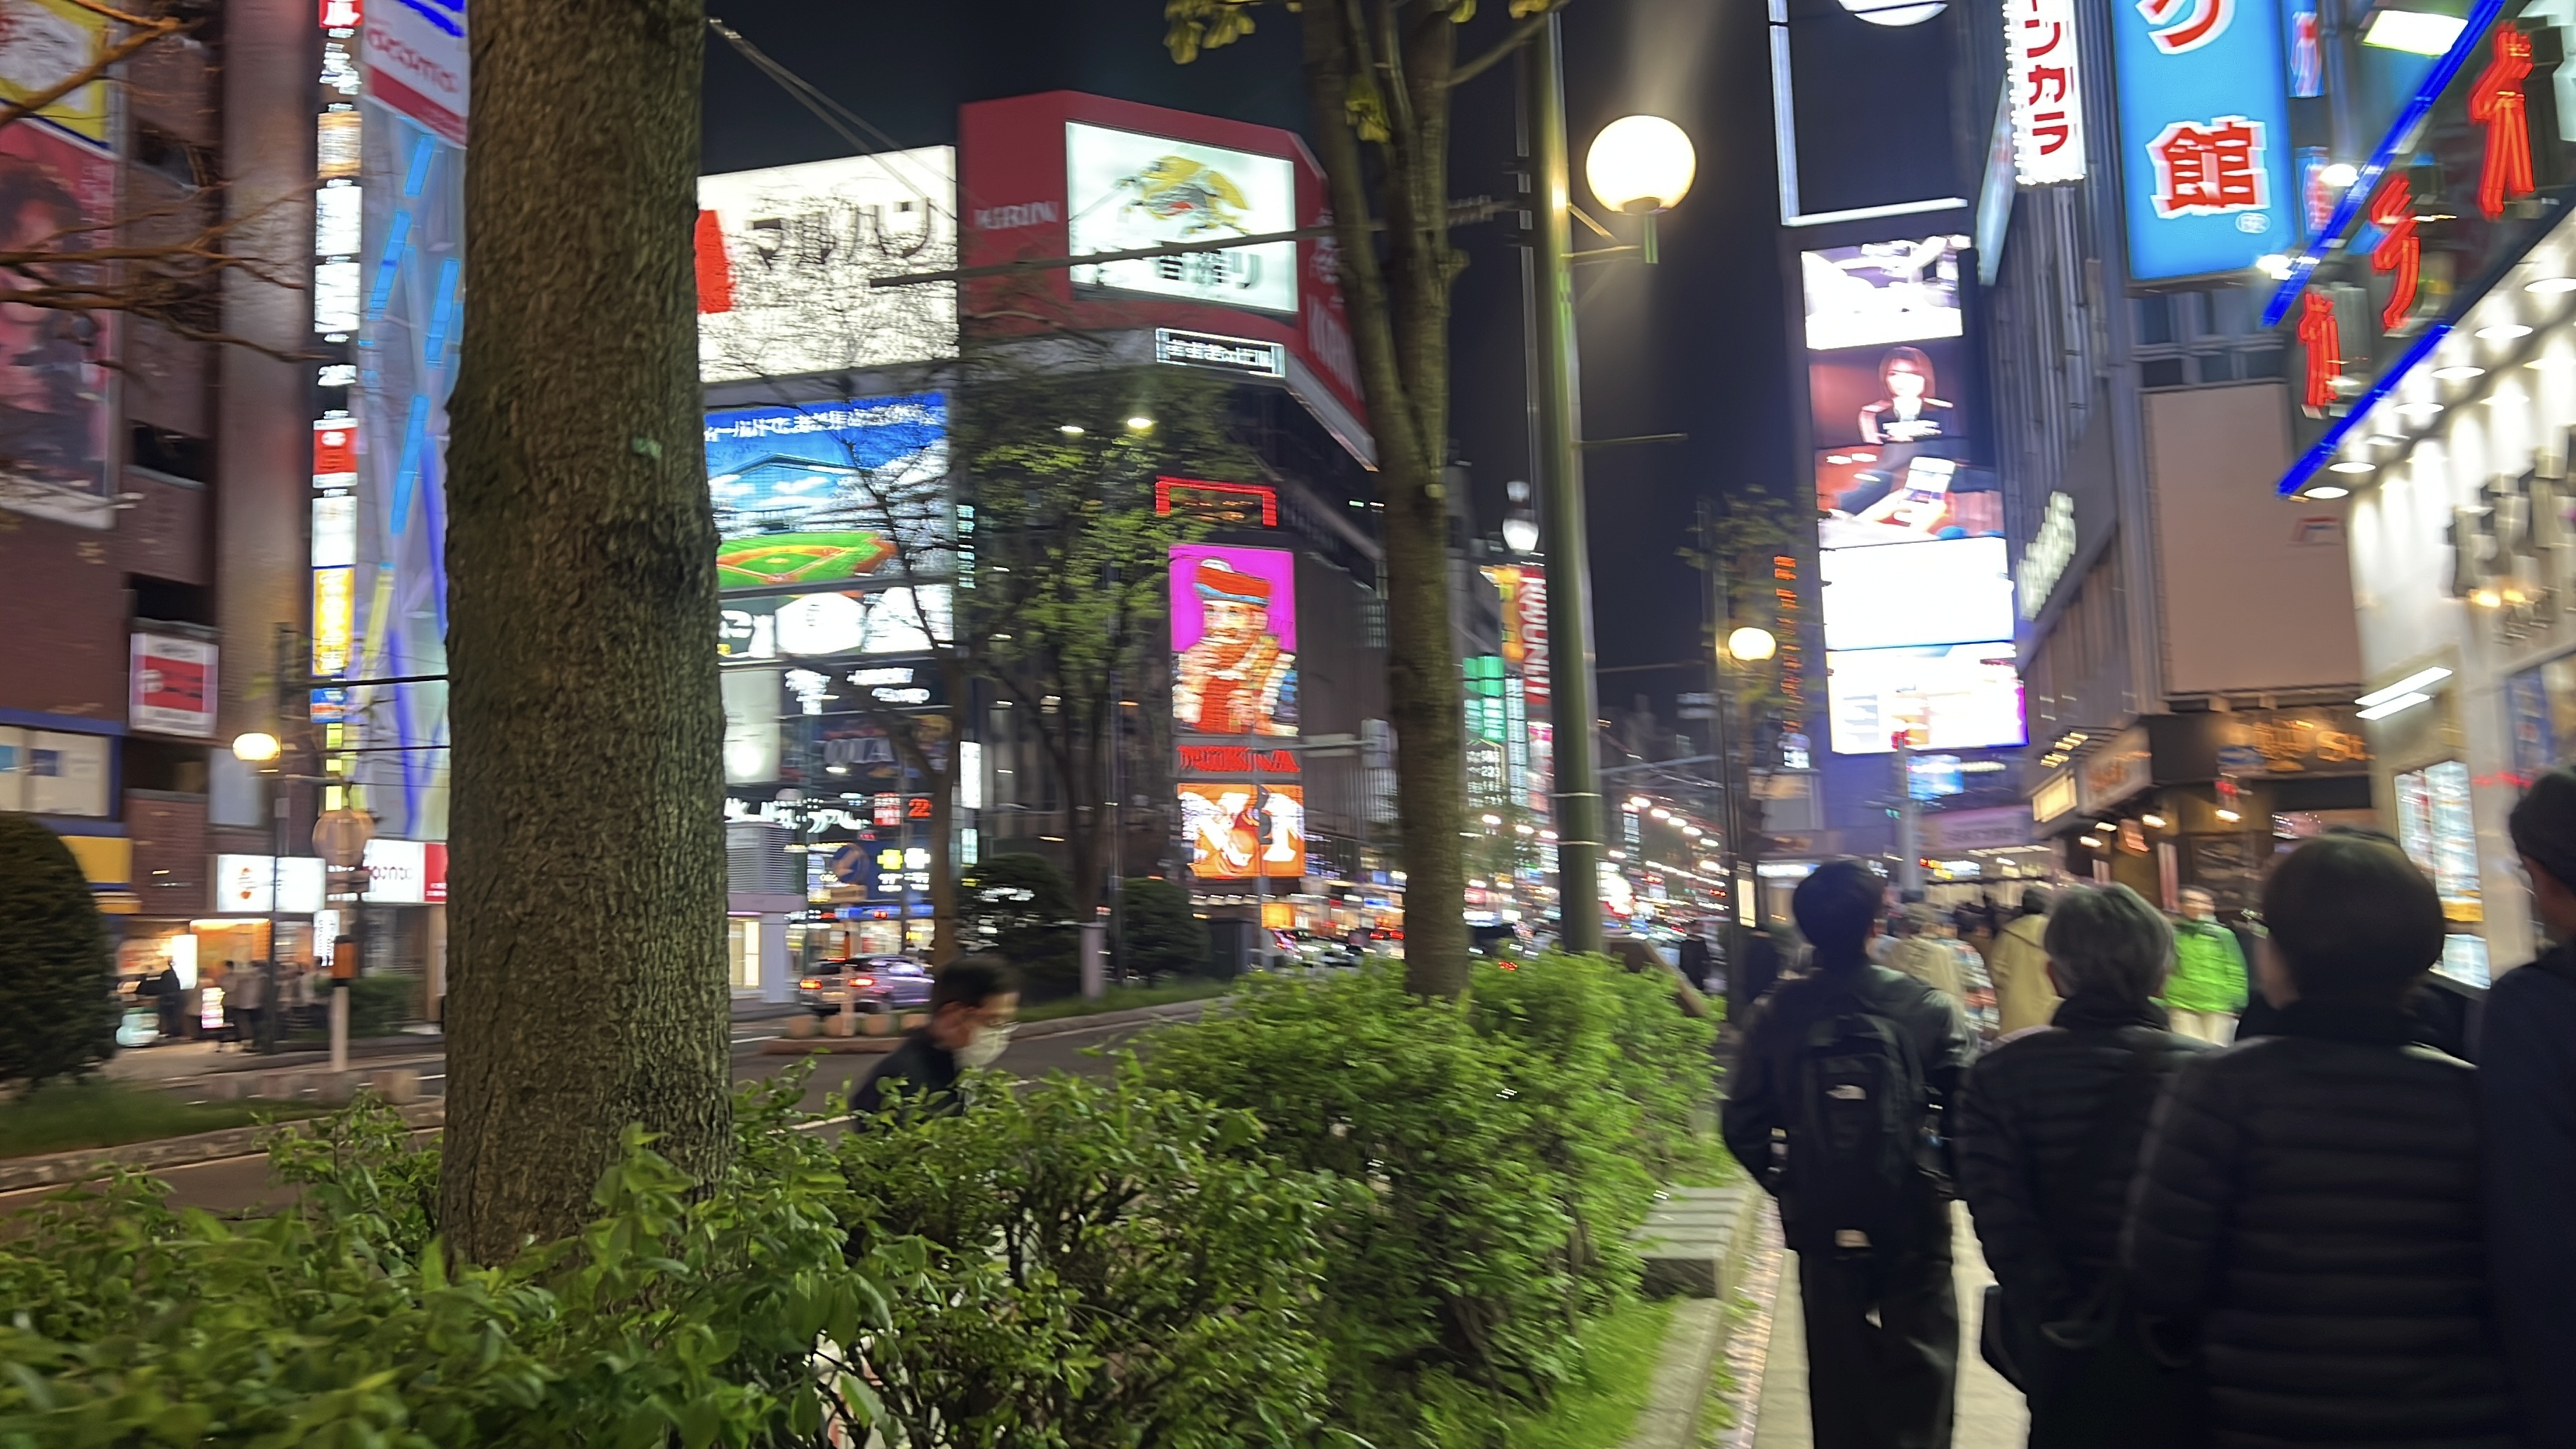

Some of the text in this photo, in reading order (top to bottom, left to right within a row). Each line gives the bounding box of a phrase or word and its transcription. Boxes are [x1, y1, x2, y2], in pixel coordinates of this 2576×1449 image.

[2023, 0, 2069, 156] ンカラ
[974, 201, 1059, 230] KIRIN
